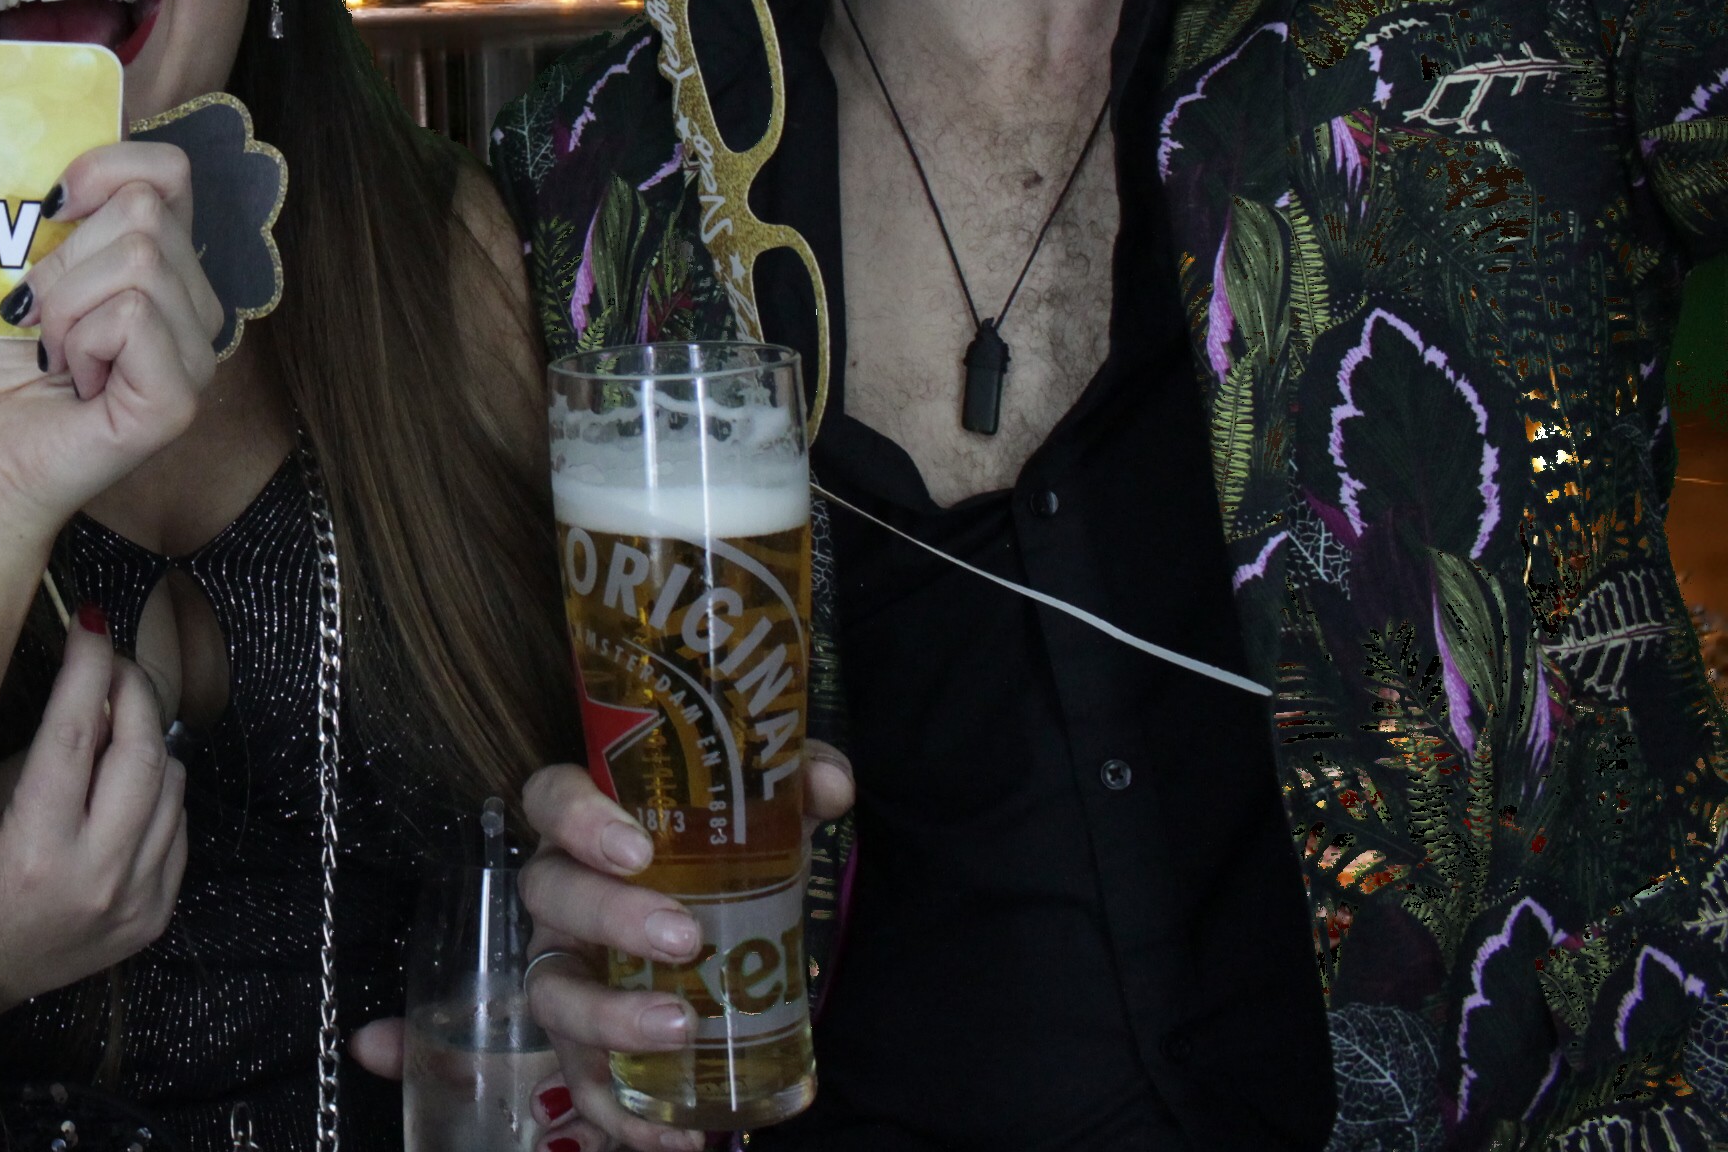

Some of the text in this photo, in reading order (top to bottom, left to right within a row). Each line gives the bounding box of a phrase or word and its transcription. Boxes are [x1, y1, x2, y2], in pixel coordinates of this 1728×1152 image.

[566, 527, 800, 801] ORIGINAL
[697, 734, 722, 769] EN
[637, 807, 685, 833] 1873
[708, 783, 728, 846] 1883
